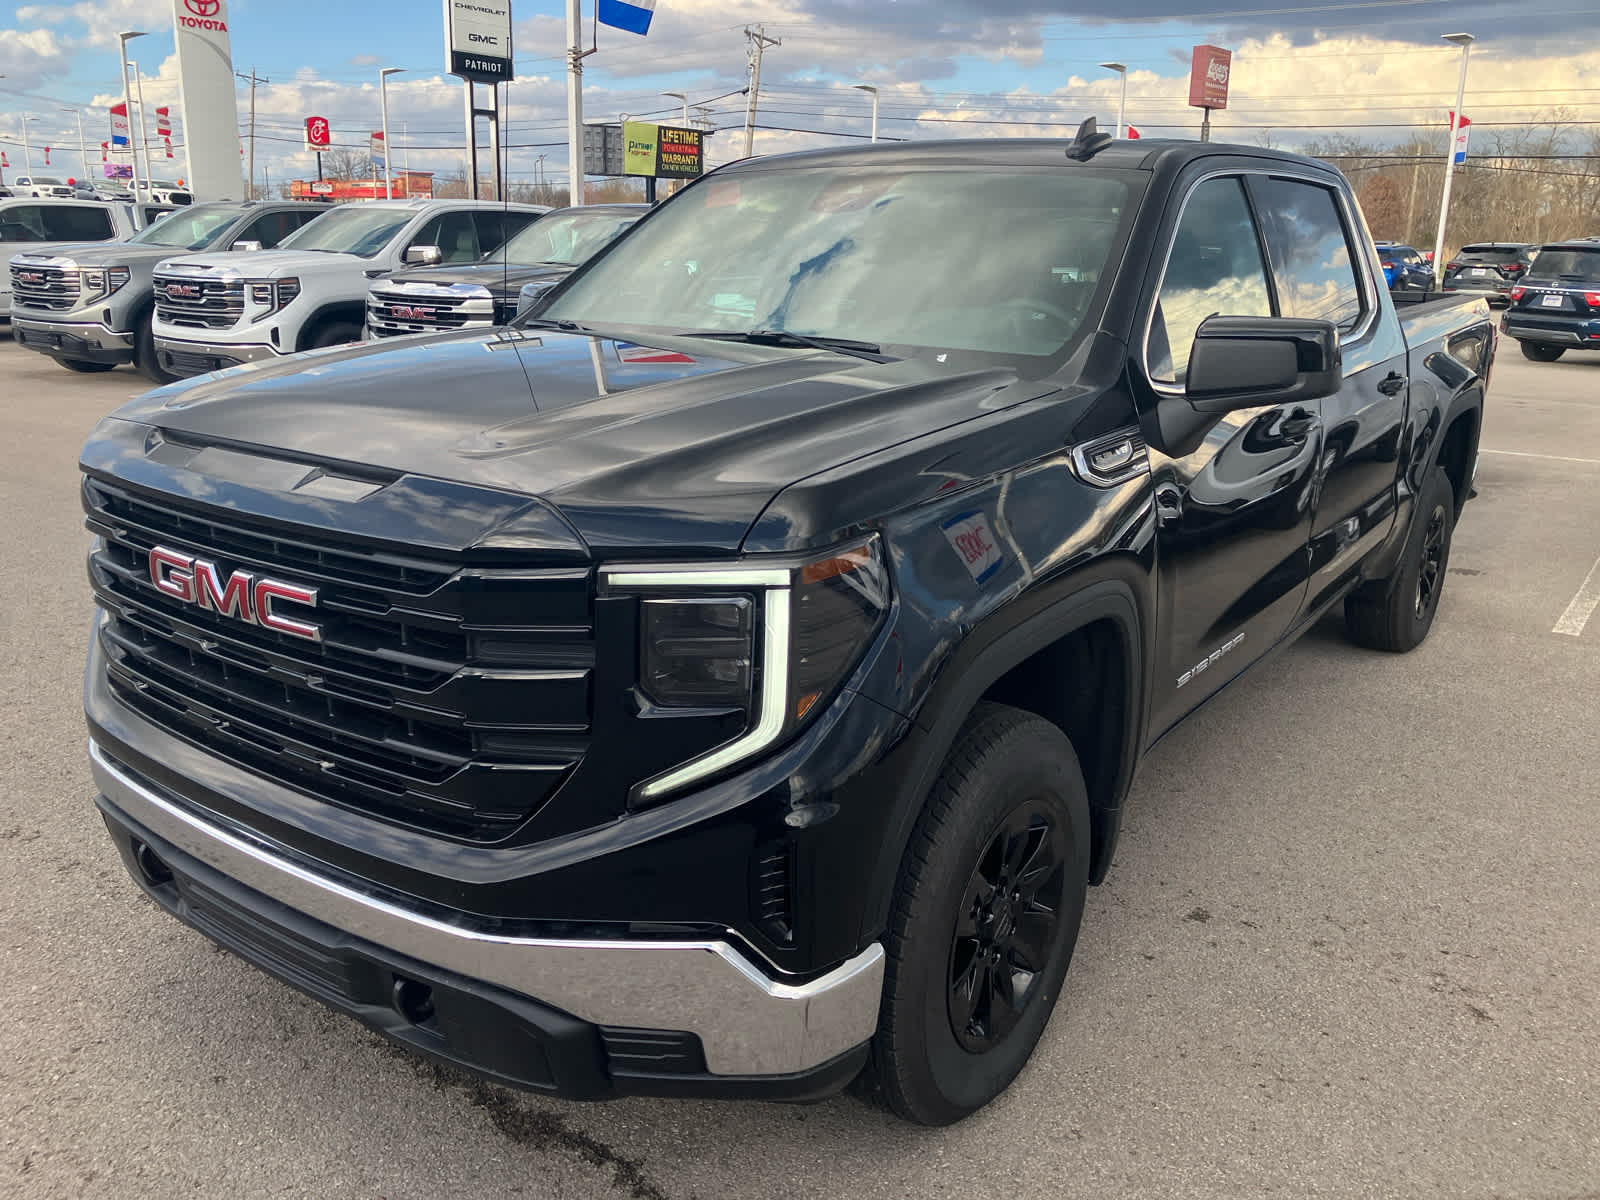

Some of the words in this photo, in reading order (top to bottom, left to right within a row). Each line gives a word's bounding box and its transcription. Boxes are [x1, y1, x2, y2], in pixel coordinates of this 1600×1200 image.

[455, 3, 506, 16] CHEVROLET
[179, 16, 227, 32] TOYOTA
[468, 33, 498, 46] GMC
[465, 59, 502, 73] PATRIOT
[661, 129, 698, 144] LIFETIME
[661, 153, 698, 164] WARRANTY
[167, 284, 200, 298] GMC
[391, 305, 436, 320] GMC
[149, 546, 321, 642] GMC
